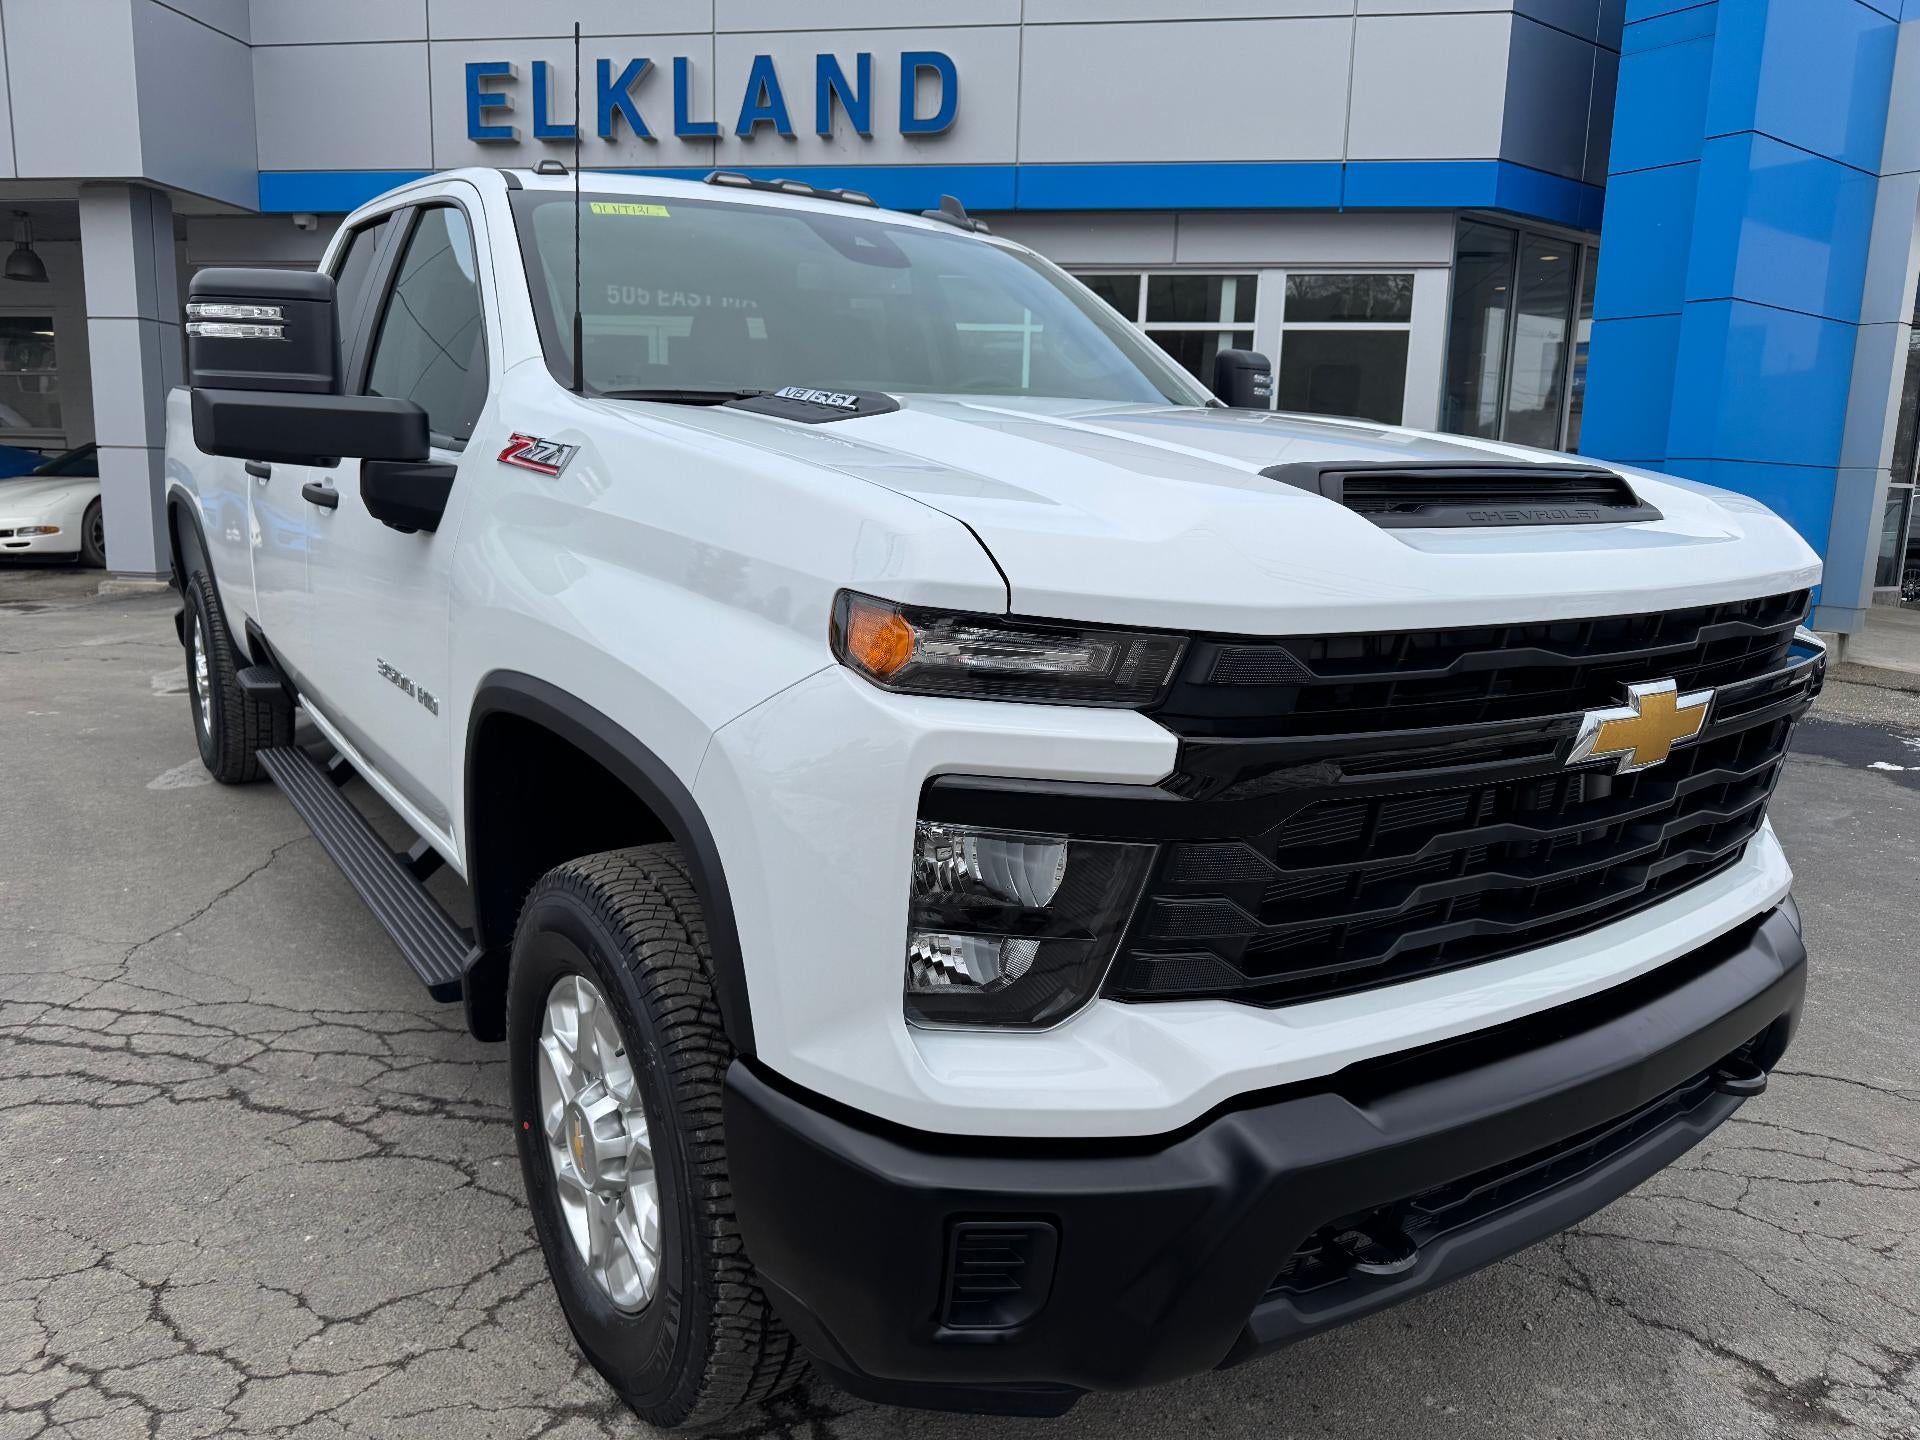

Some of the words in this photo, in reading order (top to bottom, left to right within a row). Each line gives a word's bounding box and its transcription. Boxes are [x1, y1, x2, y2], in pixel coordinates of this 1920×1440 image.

[465, 51, 960, 142] ELKLAND
[607, 284, 650, 305] 505
[497, 433, 581, 478] Z71
[1465, 508, 1600, 522] CHEVROLET
